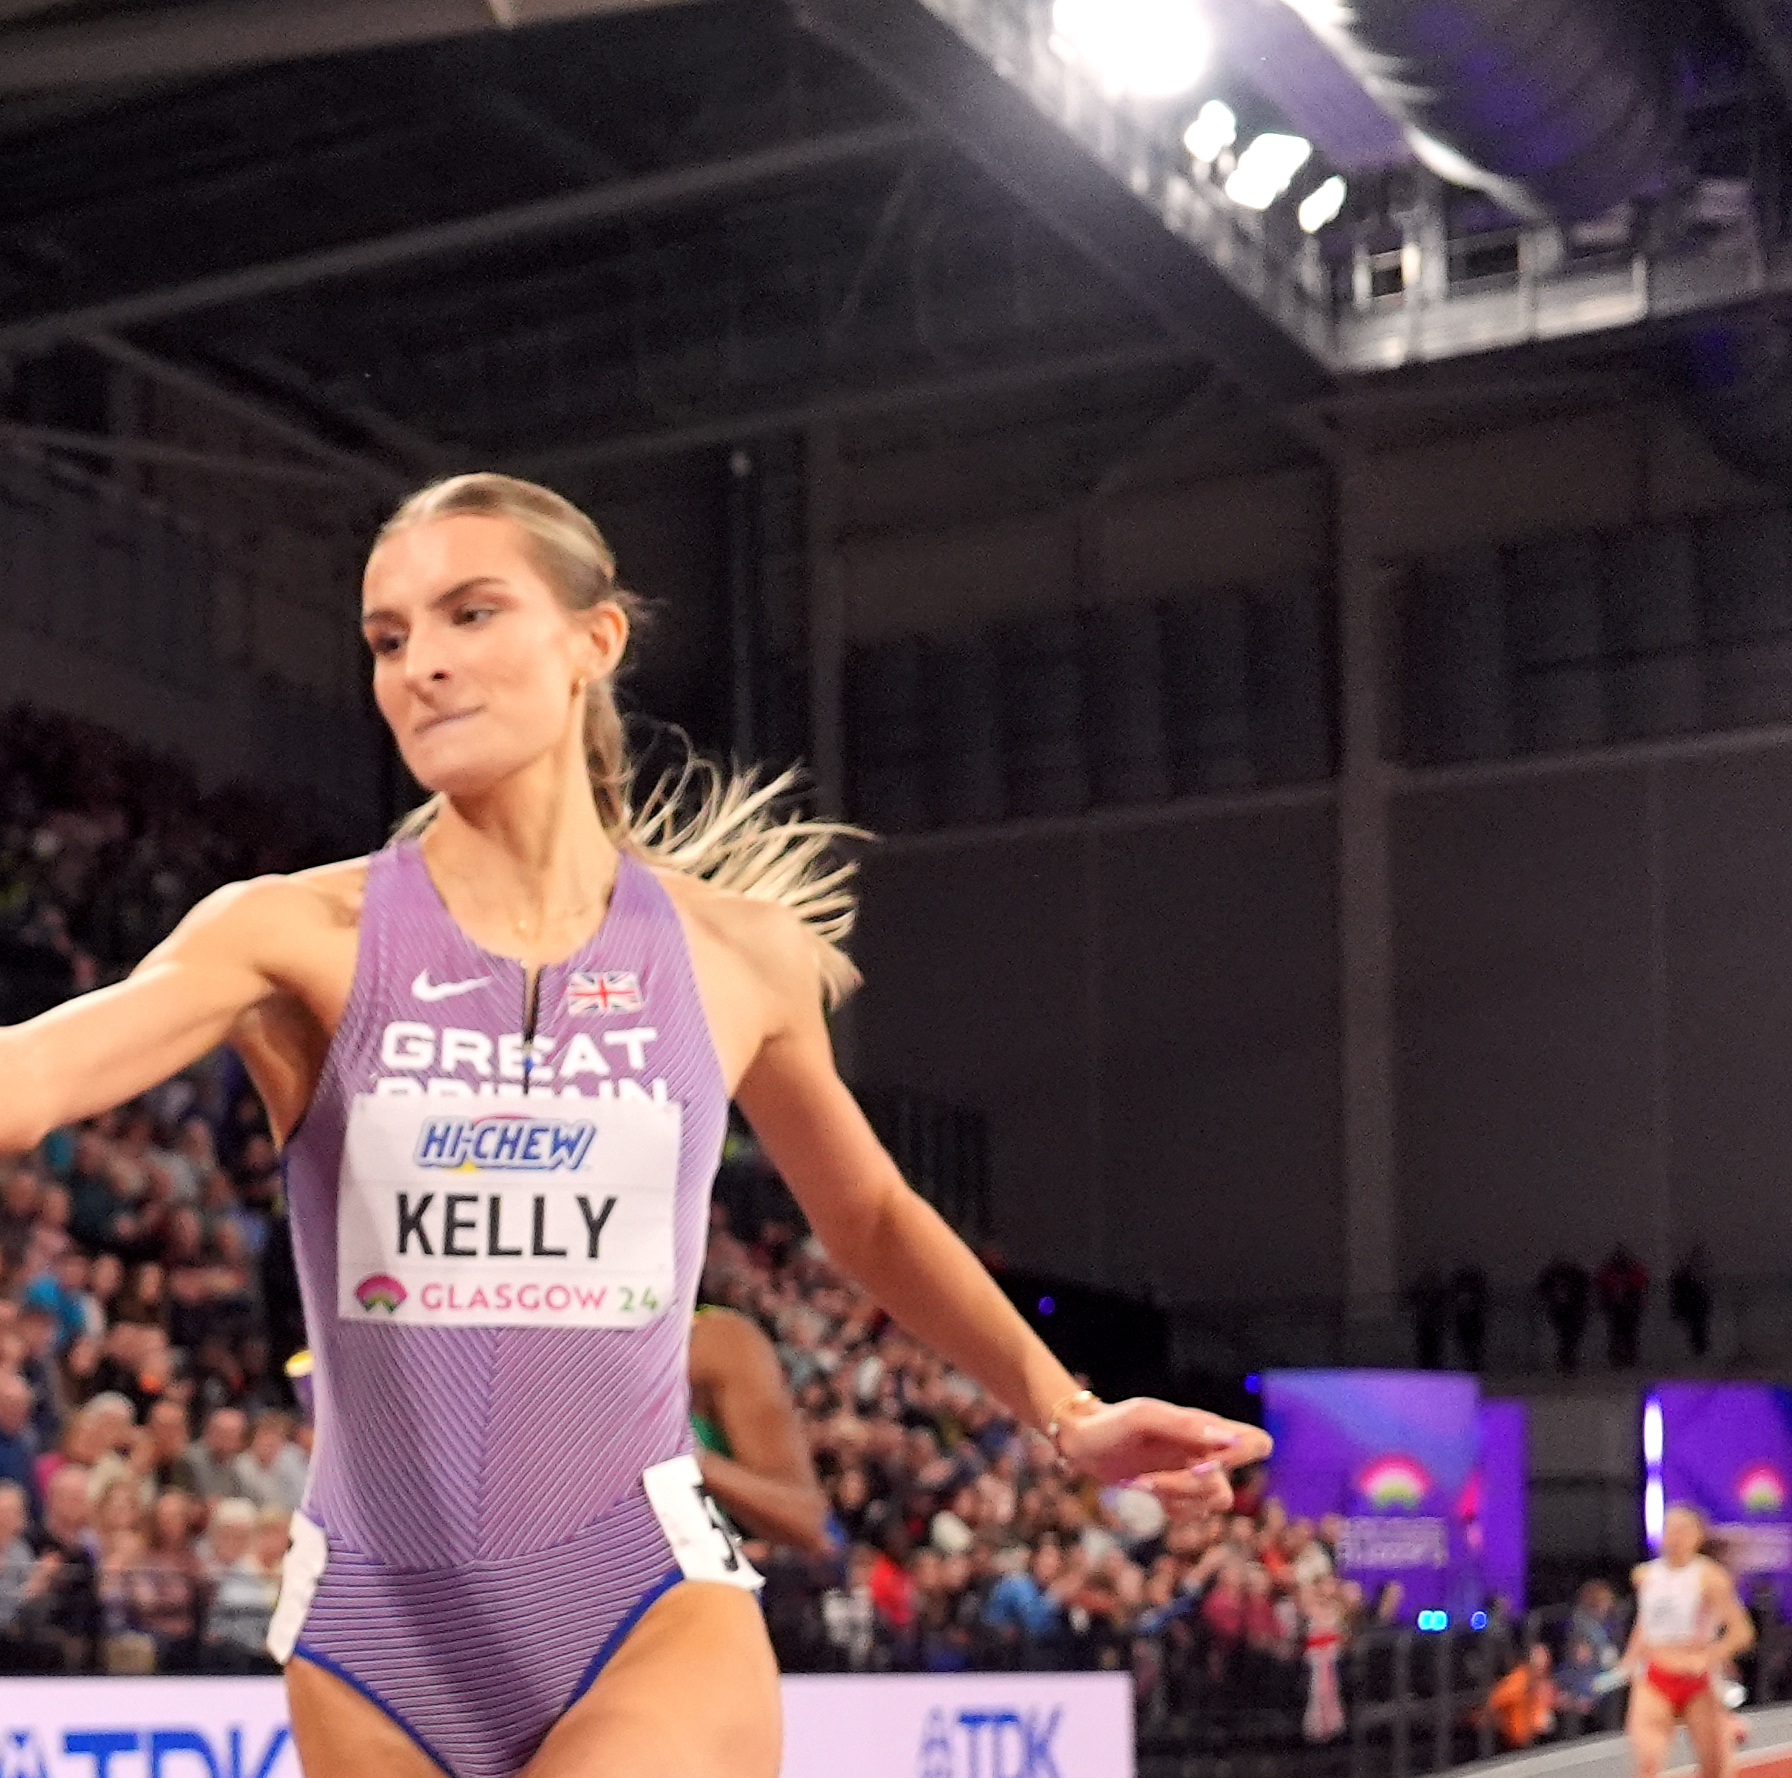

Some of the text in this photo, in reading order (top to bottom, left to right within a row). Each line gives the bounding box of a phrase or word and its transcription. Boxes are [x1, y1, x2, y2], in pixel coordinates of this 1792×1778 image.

[380, 1020, 659, 1083] GREAT
[414, 1116, 597, 1171] HI-CHEW
[395, 1191, 619, 1260] KELLY
[420, 1283, 659, 1313] GLASGOW 24
